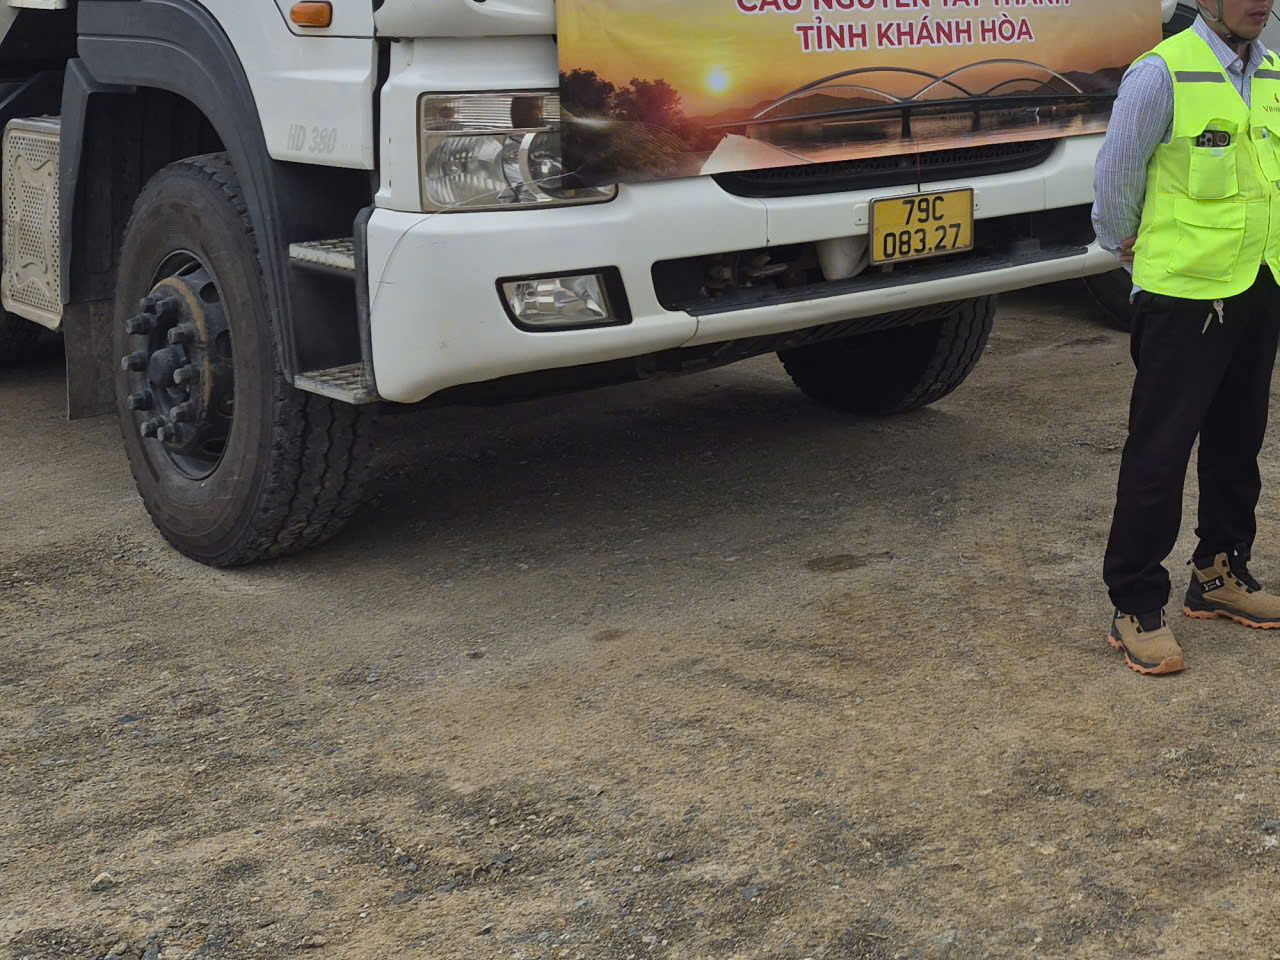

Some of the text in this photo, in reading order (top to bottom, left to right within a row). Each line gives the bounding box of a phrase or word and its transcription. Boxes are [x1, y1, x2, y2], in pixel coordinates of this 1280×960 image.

[796, 13, 1034, 52] TỈNH KHÁNH HÒA
[902, 195, 945, 226] 79C
[883, 223, 962, 259] 083.27
